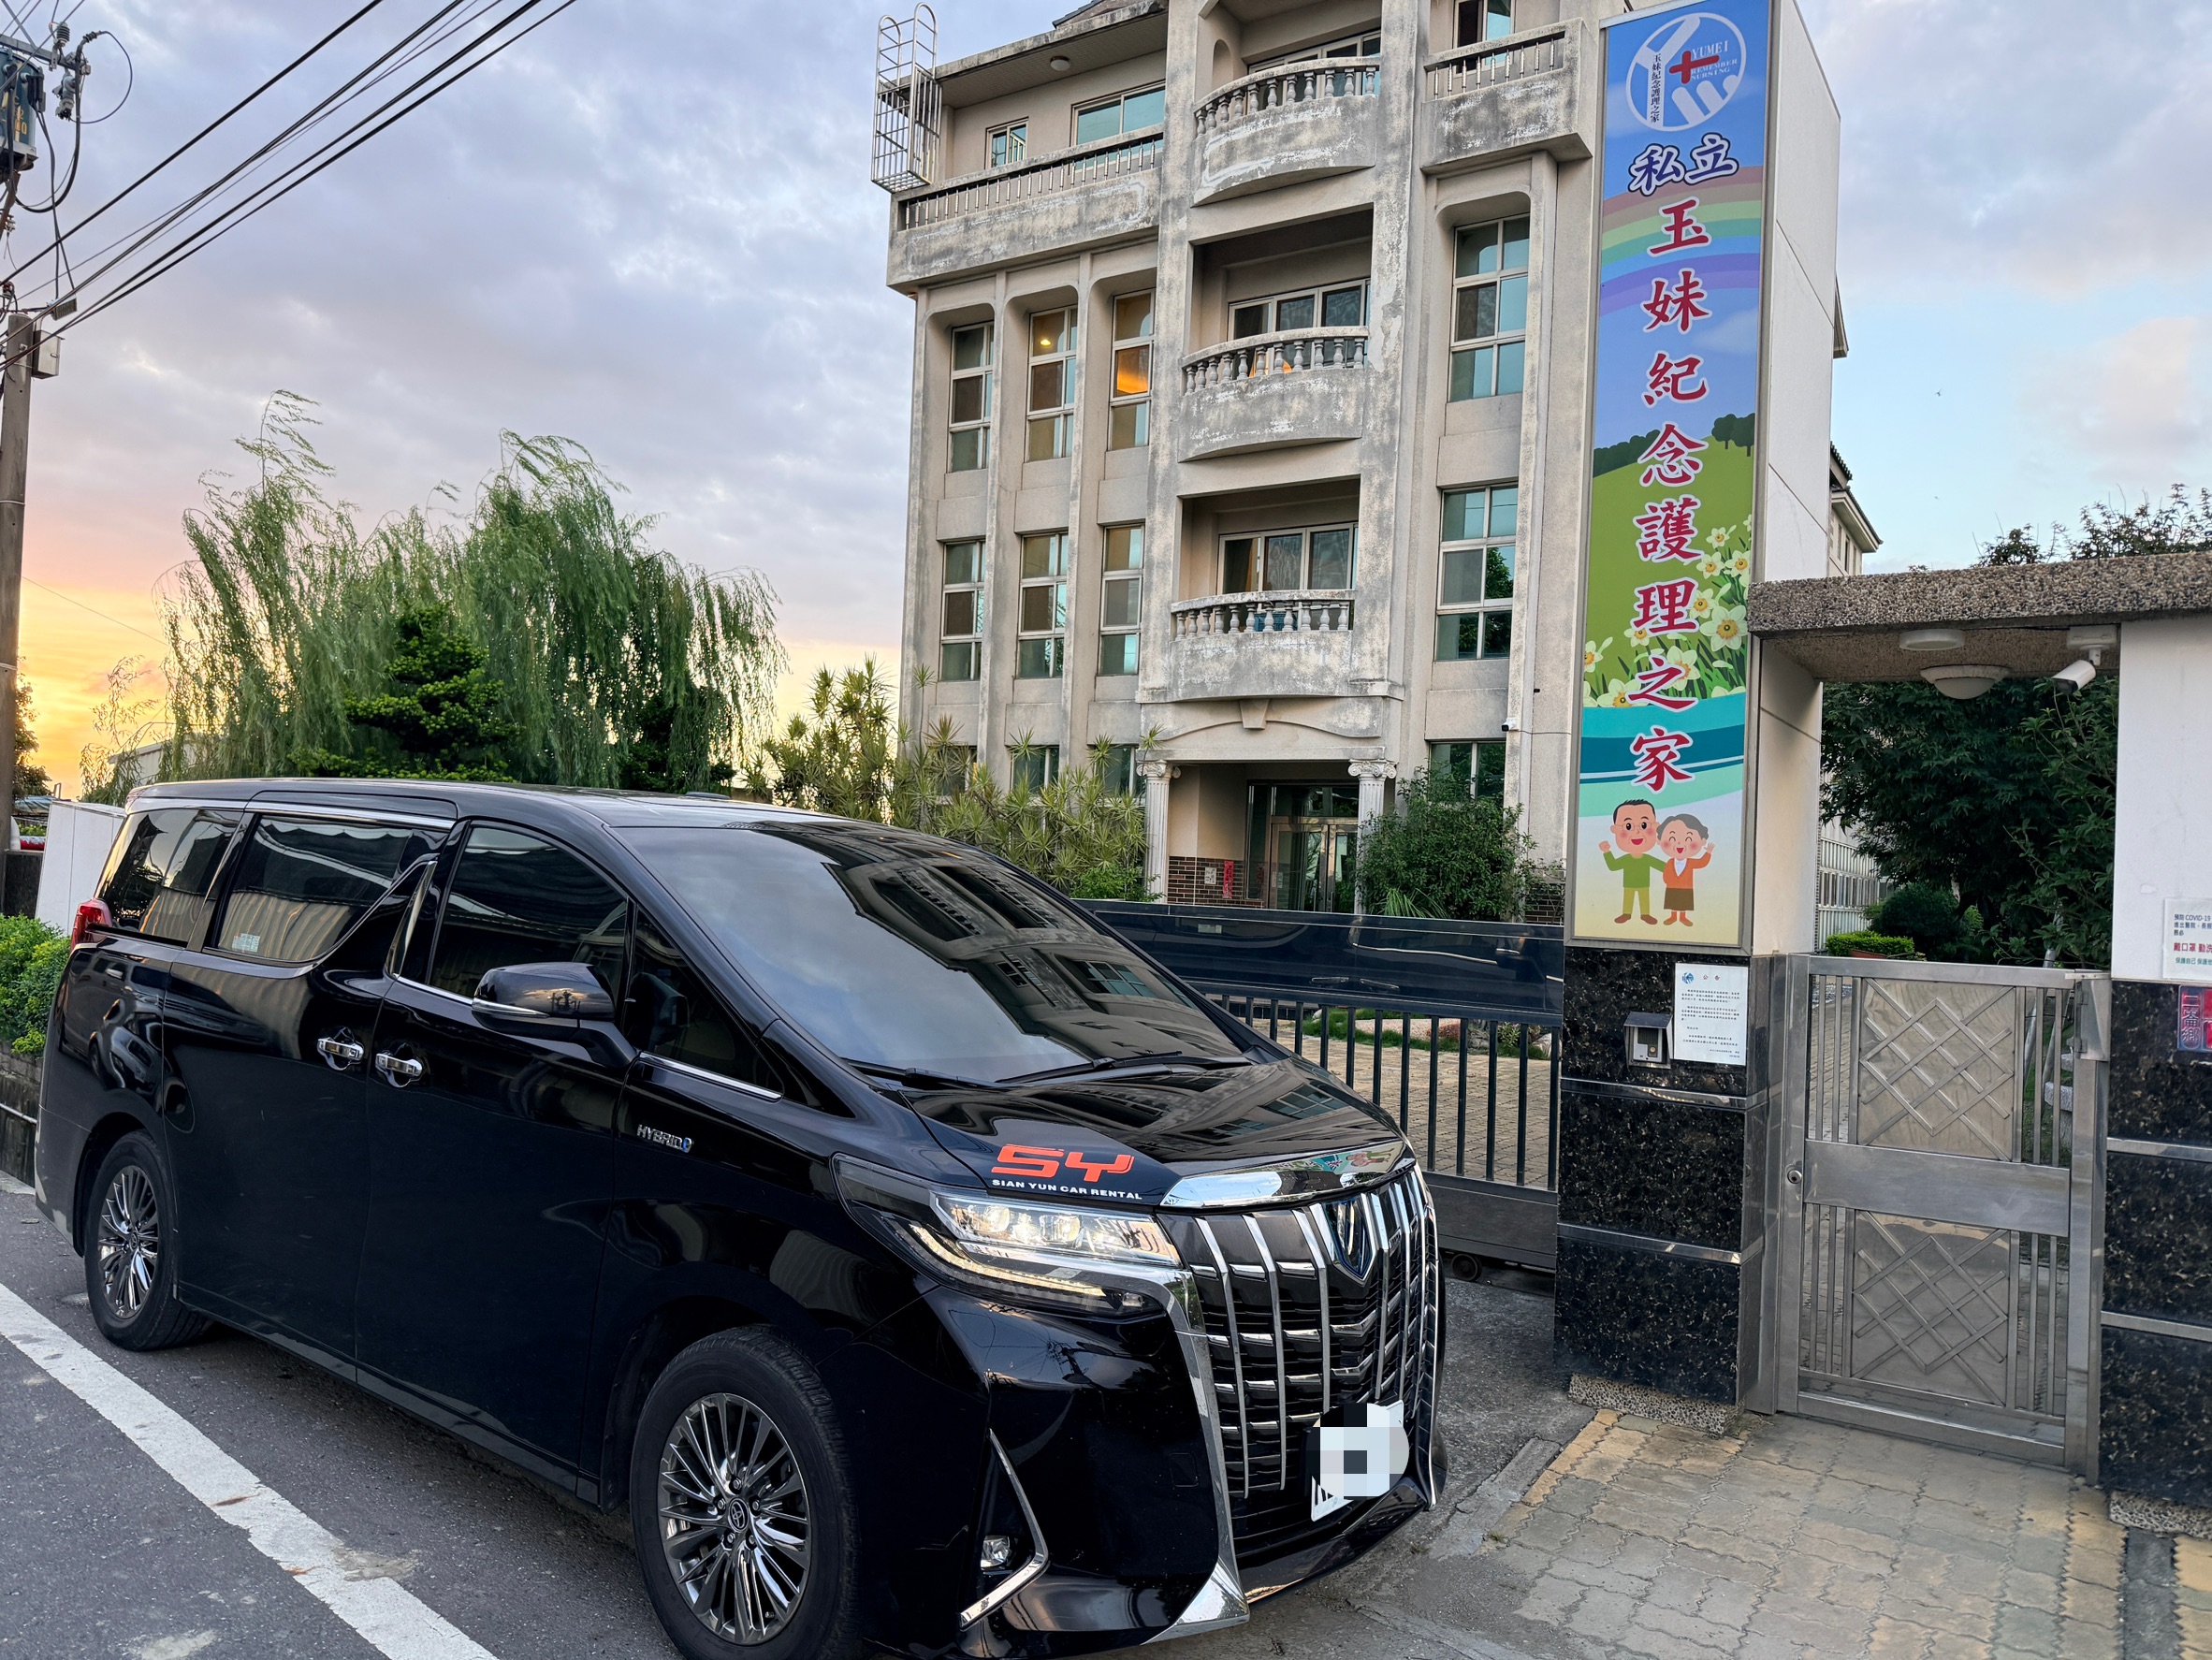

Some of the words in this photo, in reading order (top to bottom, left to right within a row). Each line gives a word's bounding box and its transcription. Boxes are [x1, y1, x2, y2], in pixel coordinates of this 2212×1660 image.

[1692, 40, 1728, 59] YUMEI
[1651, 53, 1662, 123] 玉妹紀念護理之家
[1691, 66, 1730, 80] NURSING
[1630, 134, 1738, 195] 私立
[1629, 197, 1710, 791] 玉妹紀念護理之家
[2174, 942, 2196, 952] 戴口罩
[2181, 995, 2201, 1042] 二崙鄉
[636, 1124, 683, 1151] HYBRID
[991, 1143, 1134, 1183] SY
[992, 1179, 1026, 1188] SIAN
[1028, 1182, 1057, 1191] YUN
[1060, 1186, 1087, 1195] CAR
[1090, 1188, 1142, 1200] RENTAL
